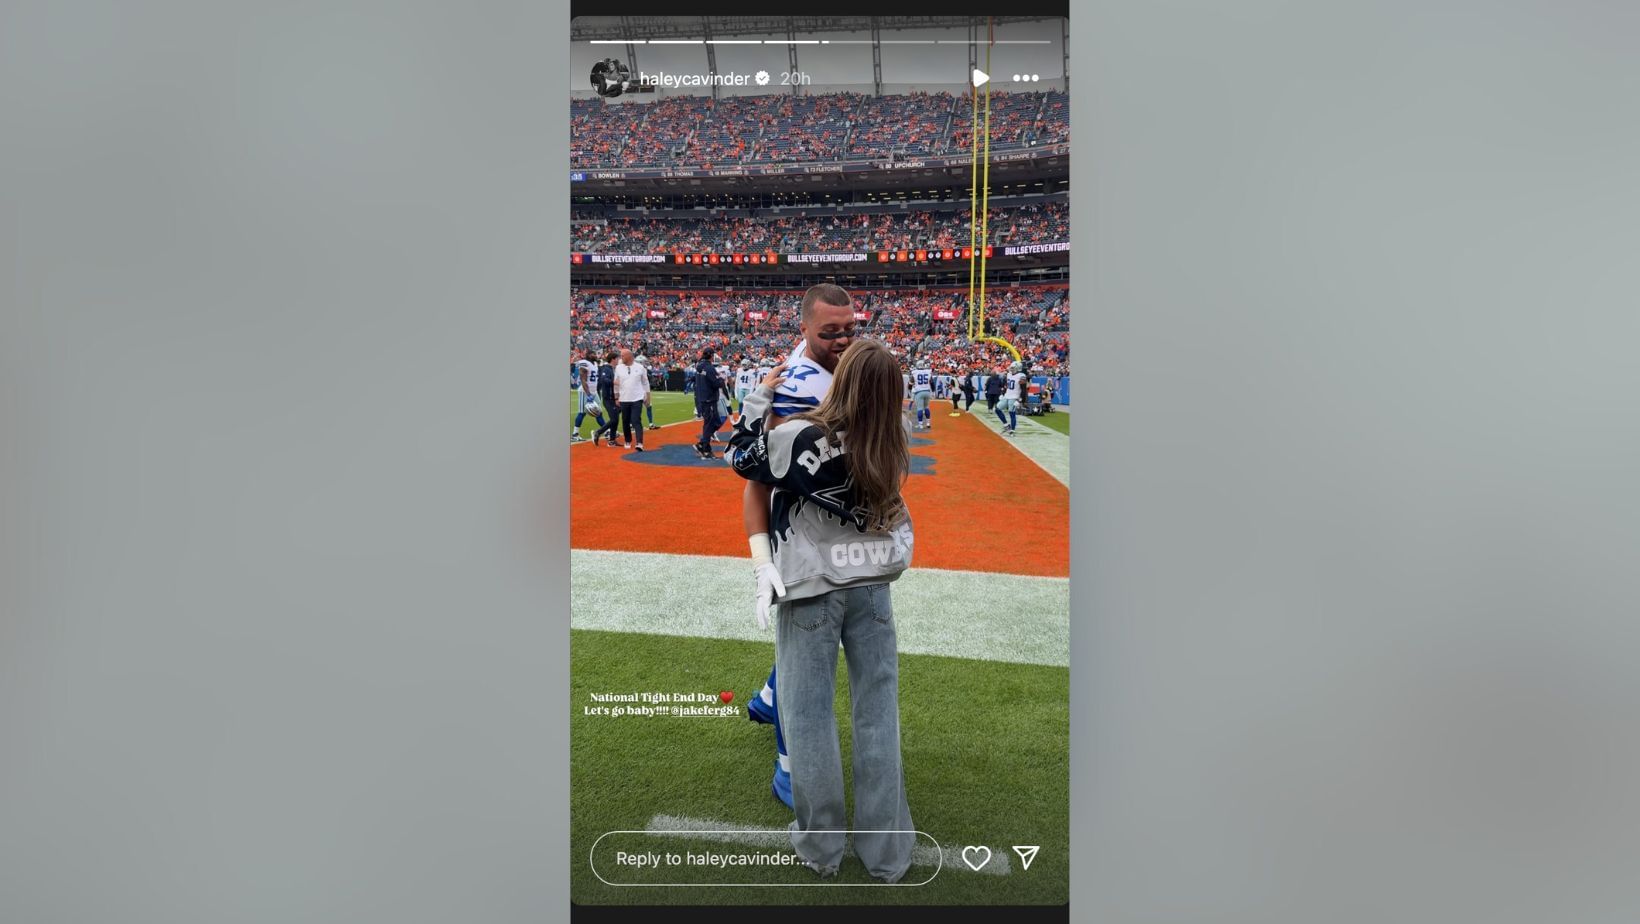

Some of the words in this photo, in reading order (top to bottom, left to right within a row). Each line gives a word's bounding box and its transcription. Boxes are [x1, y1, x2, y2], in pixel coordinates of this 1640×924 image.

[787, 253, 868, 263] BULLSEYEEVENTGROUP.COM
[740, 375, 749, 384] 41
[917, 373, 929, 385] 95
